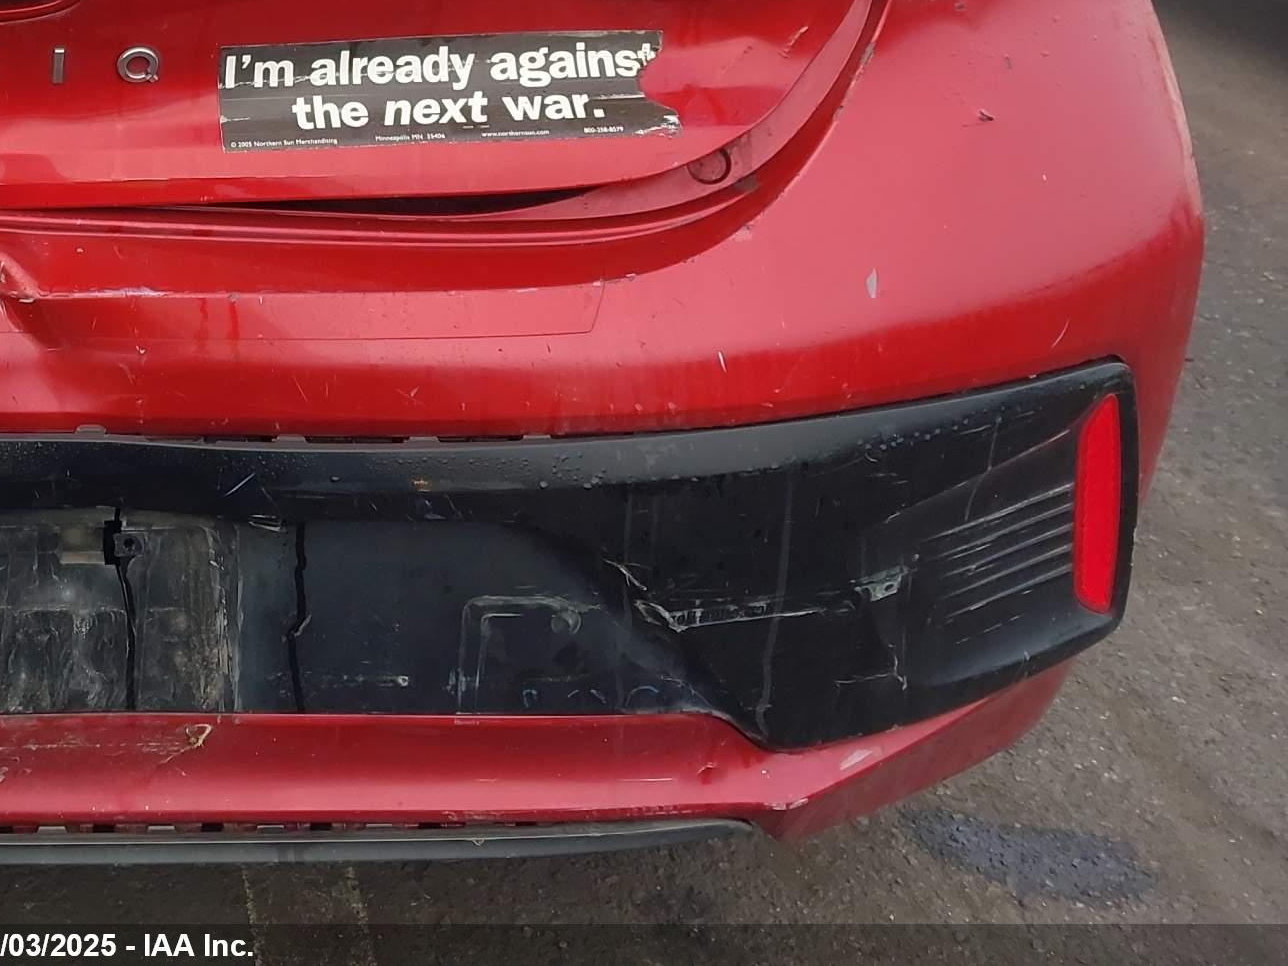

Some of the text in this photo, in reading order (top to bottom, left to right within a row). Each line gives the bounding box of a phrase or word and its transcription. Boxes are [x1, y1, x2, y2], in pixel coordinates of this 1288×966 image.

[225, 42, 656, 90] I'm already against
[292, 91, 605, 130] the next war.
[375, 134, 410, 142] Minneapolis
[481, 129, 550, 137] www.northernsun.com
